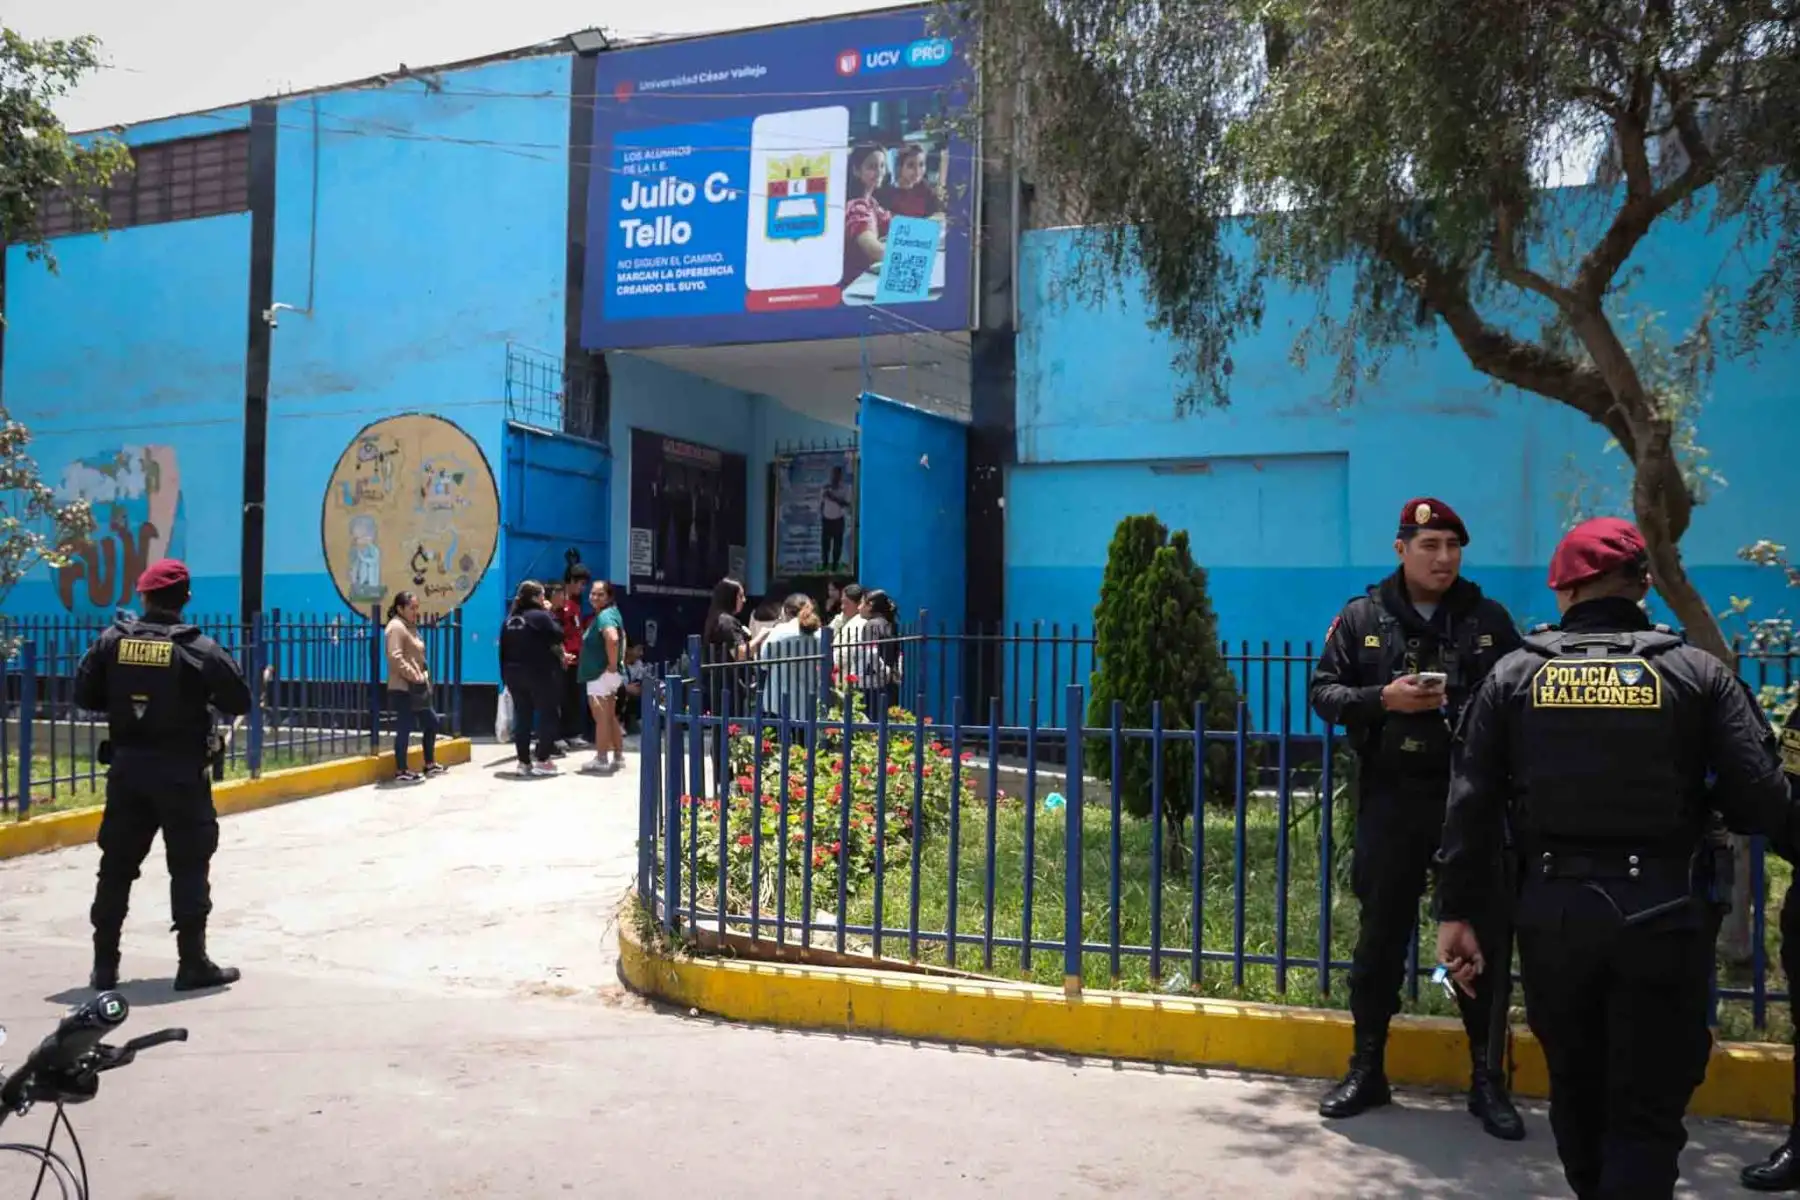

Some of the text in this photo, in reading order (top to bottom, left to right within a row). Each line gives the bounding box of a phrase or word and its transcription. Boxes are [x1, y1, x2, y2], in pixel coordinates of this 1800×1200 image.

[866, 43, 945, 69] UCV PRO
[639, 64, 768, 91] Universidad César Vallejo
[623, 145, 692, 163] LOS ALUMNOS
[623, 163, 637, 175] DE
[638, 162, 651, 173] LA
[621, 171, 737, 211] Julio C.
[620, 215, 692, 249] Tello
[617, 259, 632, 270] NO
[634, 256, 669, 269] SIGUEN
[670, 256, 681, 267] EL
[616, 265, 735, 283] MARCAN LA DIFERENCIA
[616, 280, 707, 297] CREANDO EL SUYO.
[1545, 666, 1621, 687] POLICIA
[1540, 686, 1654, 704] HALCONES
